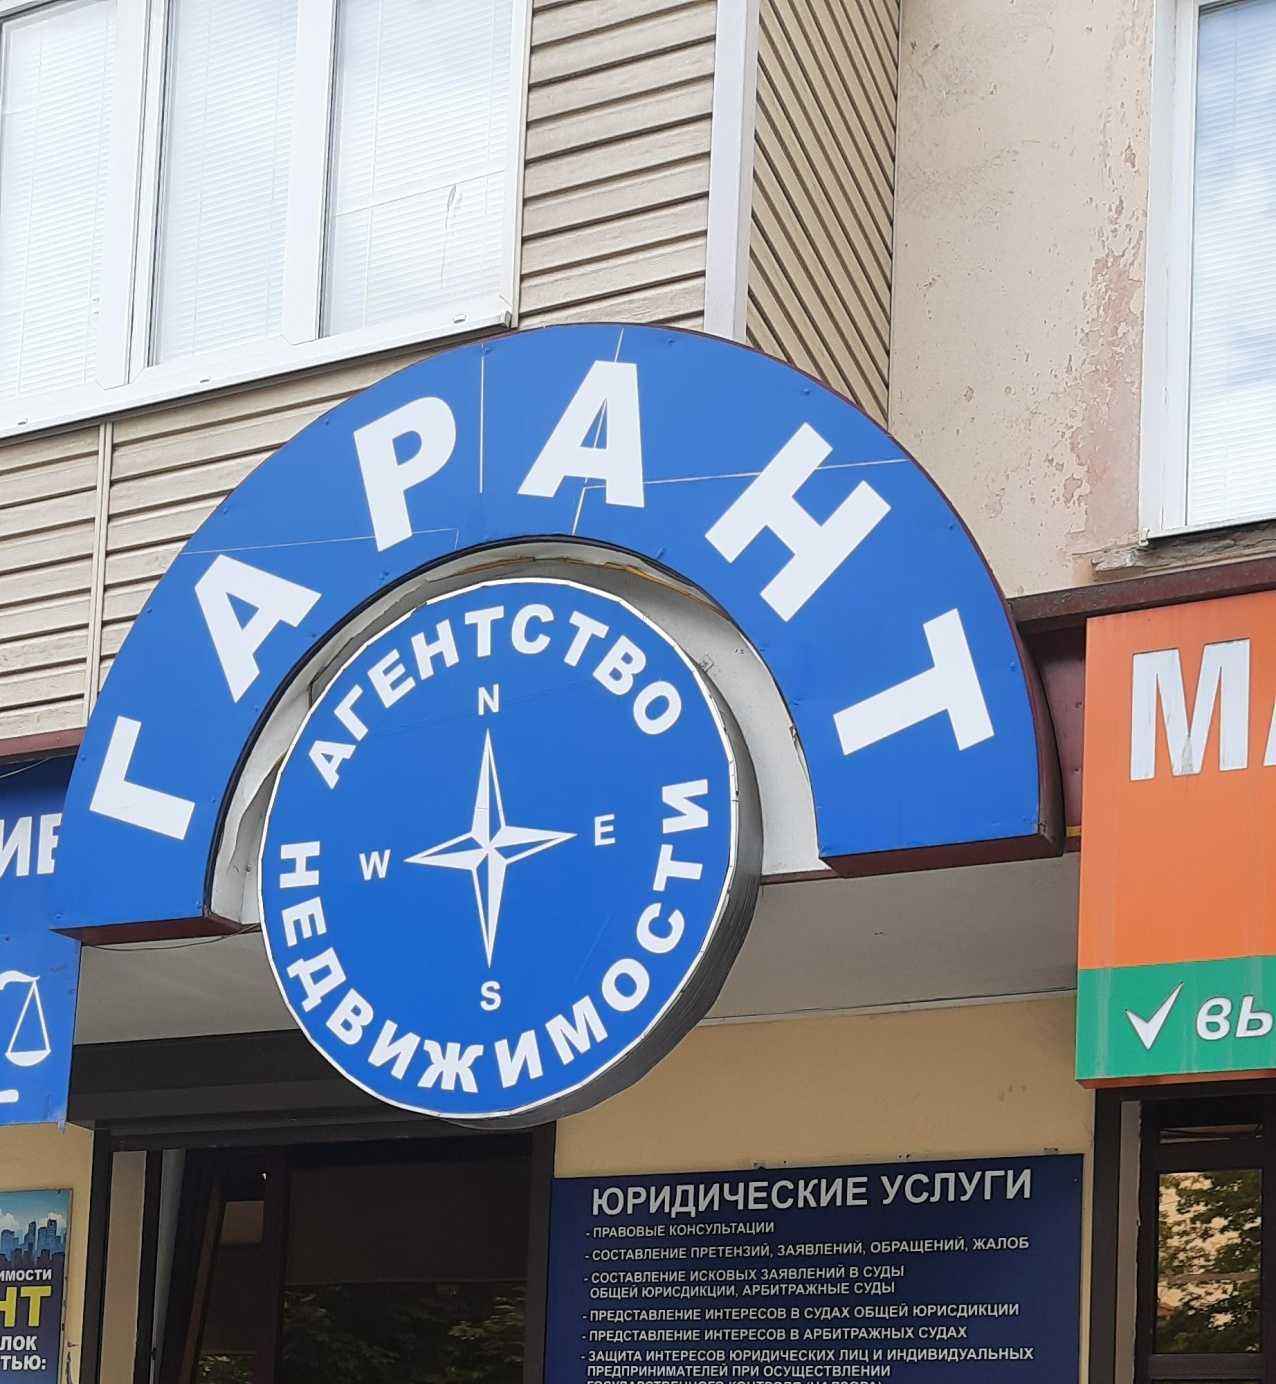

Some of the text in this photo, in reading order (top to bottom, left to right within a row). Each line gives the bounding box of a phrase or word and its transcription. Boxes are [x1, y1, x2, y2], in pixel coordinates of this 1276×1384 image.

[89, 360, 996, 842] ГАРАНТ
[308, 604, 682, 789] АГЕНТСТВО
[477, 683, 501, 716] N
[1130, 638, 1276, 782] М
[594, 813, 616, 846] E
[359, 849, 391, 881] W
[279, 778, 710, 1093] НЕДВИЖИМОСТИ
[480, 980, 502, 1012] S
[592, 1169, 1032, 1218] ЮРИДИЧЕСКИЕ УСЛУГИ
[593, 1225, 666, 1239] ПРАВОВЫЕ
[669, 1222, 775, 1237] КОНСУЛЬТАЦИИ
[592, 1248, 687, 1261] СОСТАВЛЕНИЕ
[691, 1243, 774, 1258] ПРЕТЕНЗИЙ,
[777, 1240, 866, 1257] ЗАЯВЛЕНИЙ,
[870, 1236, 968, 1253] ОБРАЩЕНИЙ,
[973, 1236, 1029, 1250] ЖАЛОБ
[591, 1271, 686, 1284] СОСТАВЛЕНИЕ
[690, 1269, 757, 1282] ИСКОВЫХ
[761, 1265, 845, 1280] ЗАЯВЛЕНИЙ
[849, 1266, 859, 1278] В
[863, 1265, 905, 1279] СУДЫ
[590, 1282, 895, 1300] ОБЩЕЙ ЮРИСДИКЦИИ, АРБИТРАЖНЫЕ СУДЫ
[590, 1309, 701, 1322] ПРЕДСТАВЛЕНИЕ
[705, 1308, 787, 1320] ИНТЕРЕСОВ
[790, 1308, 800, 1319] В
[804, 1306, 850, 1320] СУДАХ
[854, 1302, 909, 1319] ОБЩЕЙ
[912, 1303, 1019, 1318] ЮРИСДИКЦИИ
[589, 1329, 700, 1343] ПРЕДСТАВЛЕНИЕ
[704, 1329, 786, 1341] ИНТЕРЕСОВ
[790, 1329, 799, 1340] В
[803, 1327, 914, 1340] АРБИТРАЖНЫХ
[918, 1326, 967, 1340] СУДАХ
[587, 1363, 891, 1379] ПРЕДПРИНИМАТЕЛЕЙ ПРИ ОСУЩЕСТВЛЕНИИ
[588, 1350, 641, 1363] ЗАЩИТА
[645, 1350, 726, 1362] ИНТЕРЕСОВ
[729, 1349, 835, 1362] ЮРИДИЧЕСКИХ
[839, 1349, 869, 1363] ЛИЦ
[873, 1350, 882, 1360] И
[887, 1347, 1034, 1362] ИНДИВИДУАЛЬНЫХ
